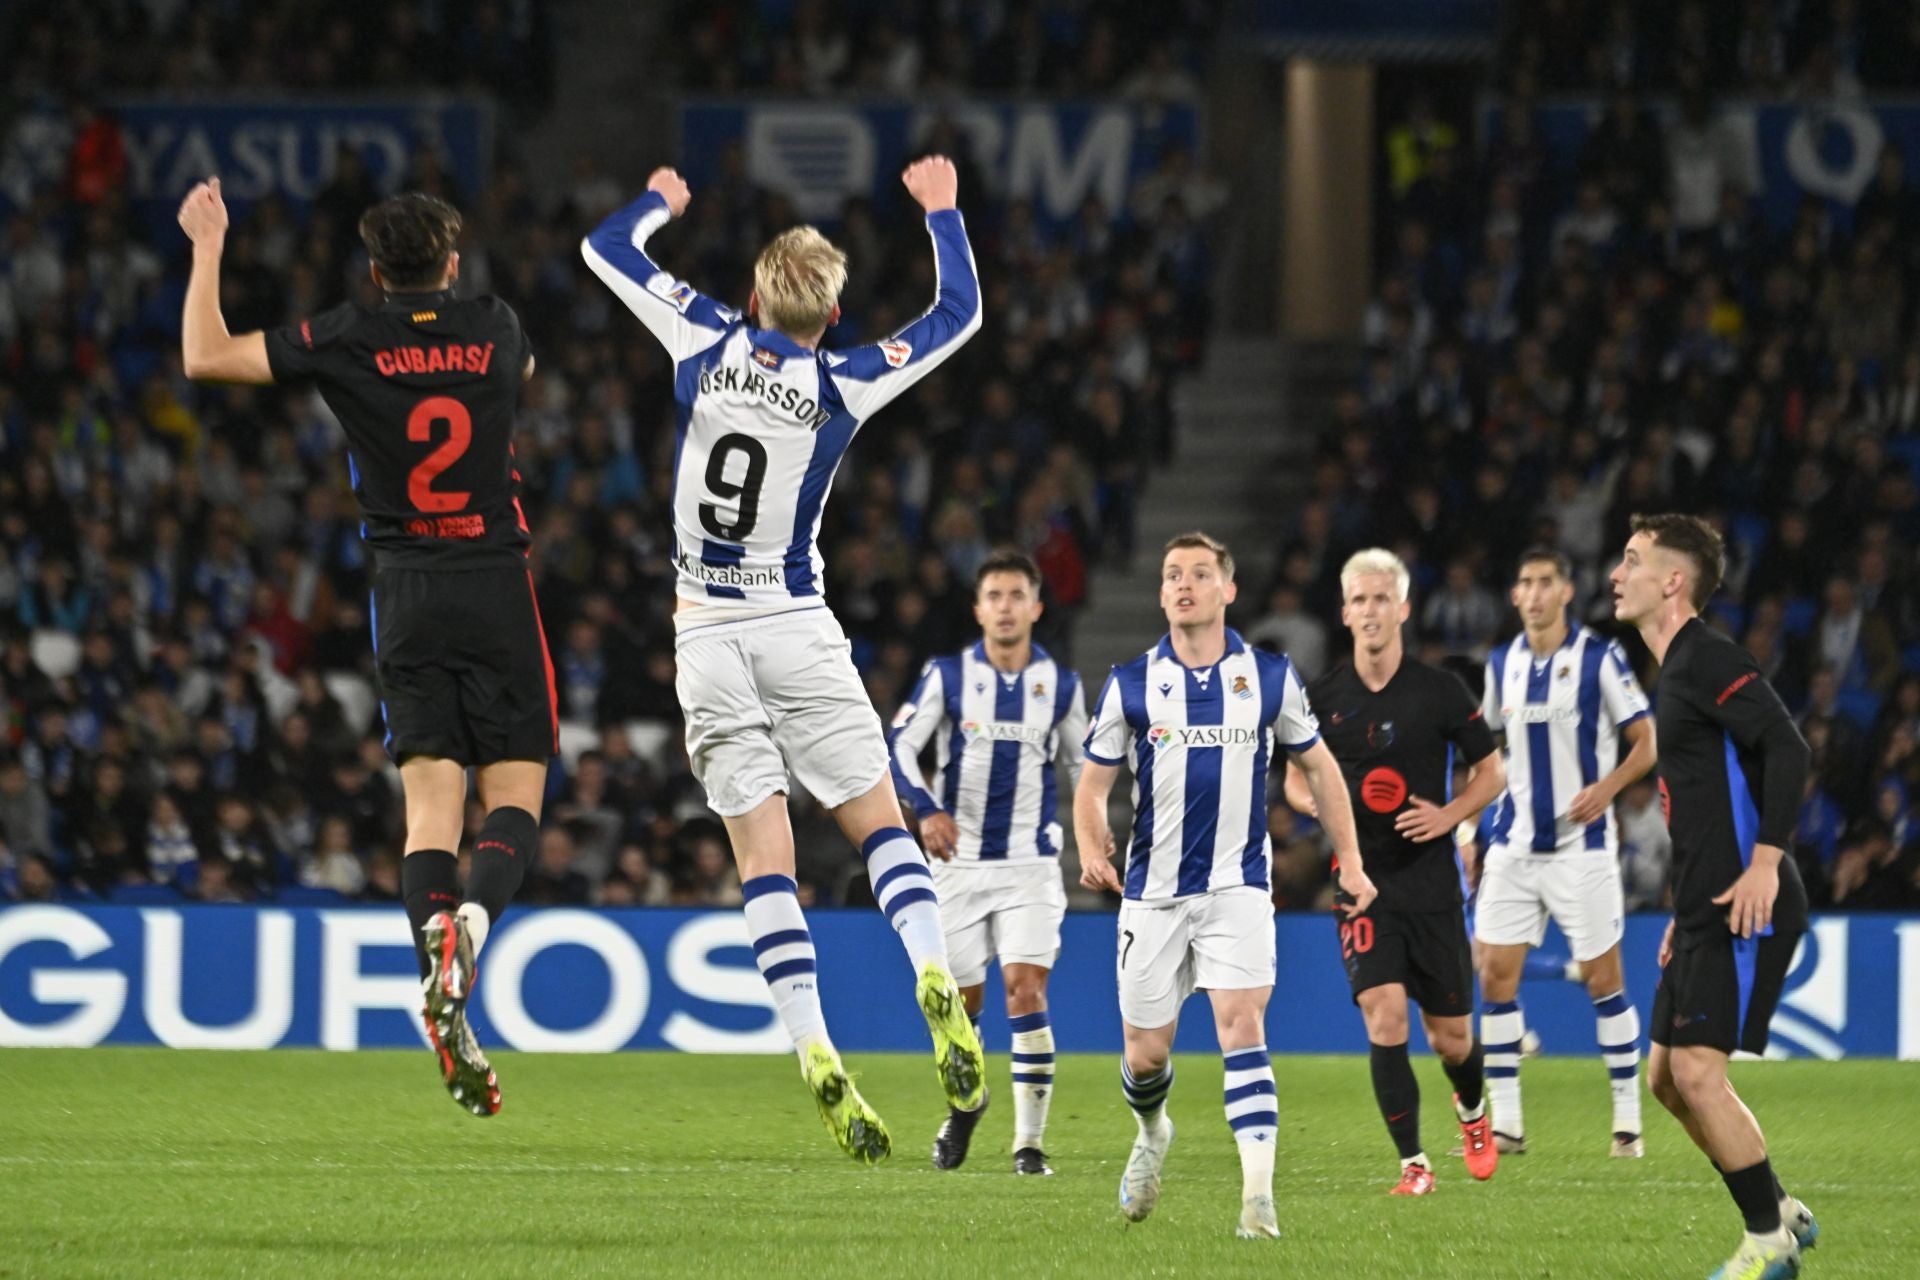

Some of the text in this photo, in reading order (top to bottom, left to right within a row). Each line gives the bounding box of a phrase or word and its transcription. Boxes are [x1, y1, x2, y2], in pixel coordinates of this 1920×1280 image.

[375, 341, 494, 376] CUBARSÍ
[407, 396, 472, 513] 2
[699, 432, 768, 541] 9
[1179, 728, 1256, 745] YASUDA
[1123, 929, 1135, 970] 7
[1341, 916, 1375, 959] 20
